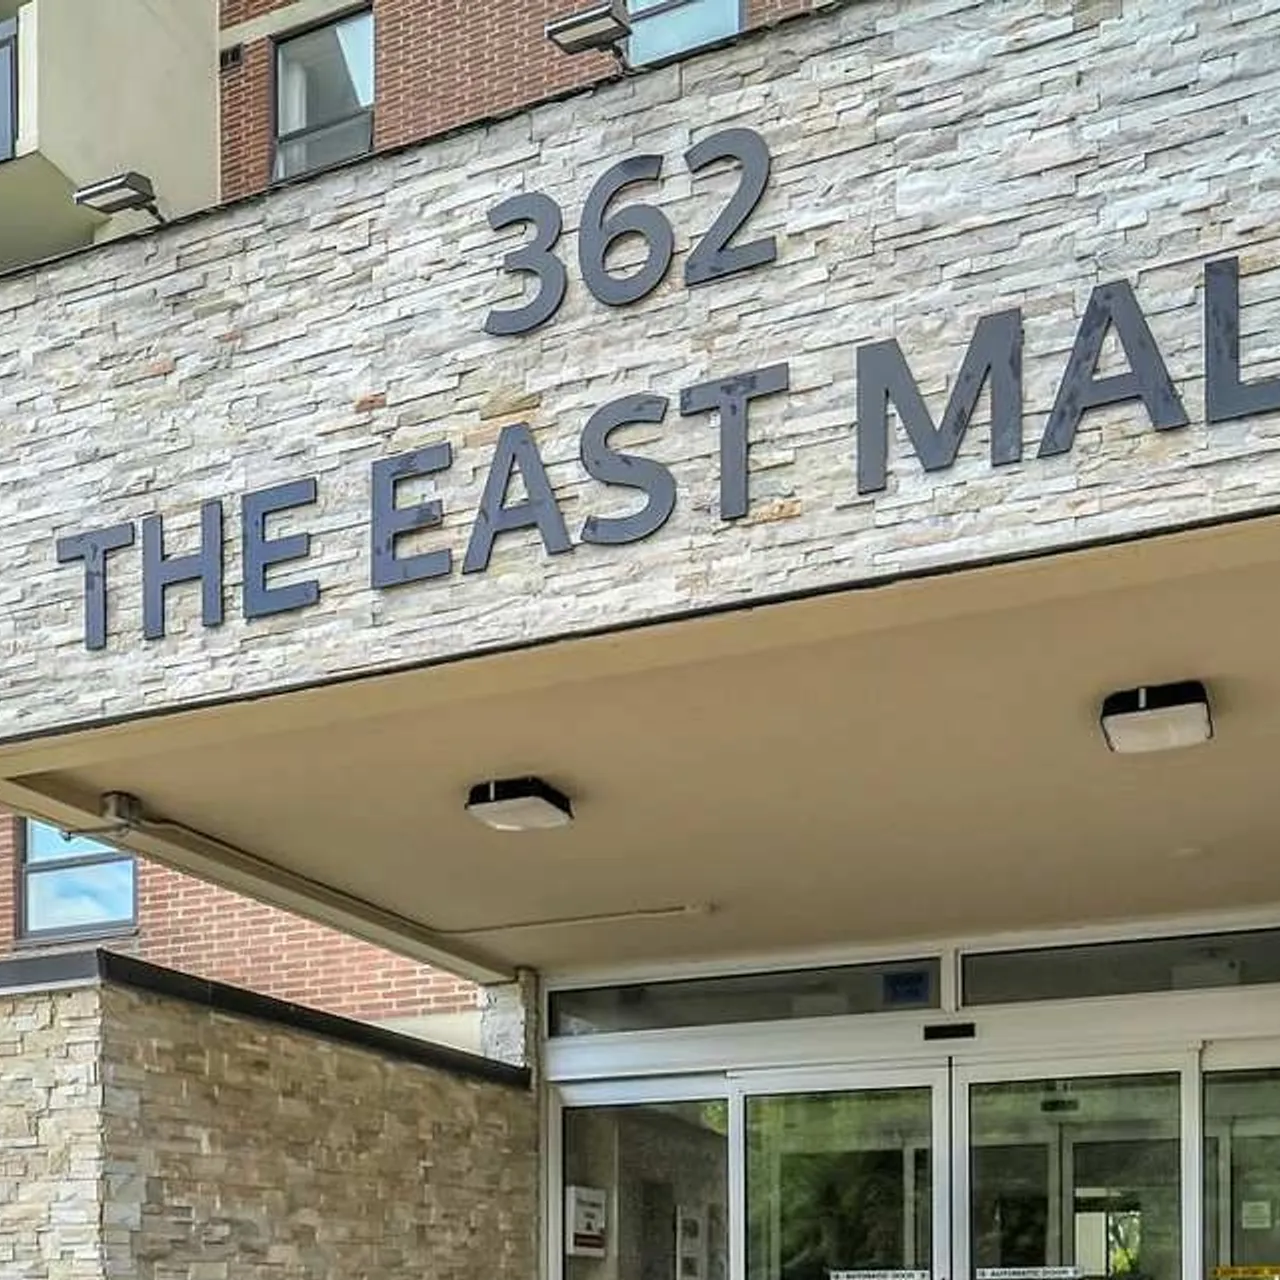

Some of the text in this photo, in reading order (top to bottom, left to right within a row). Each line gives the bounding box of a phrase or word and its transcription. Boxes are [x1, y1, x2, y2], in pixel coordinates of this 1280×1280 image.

[484, 127, 777, 338] 362
[55, 477, 321, 652] THE
[370, 361, 790, 590] EAST
